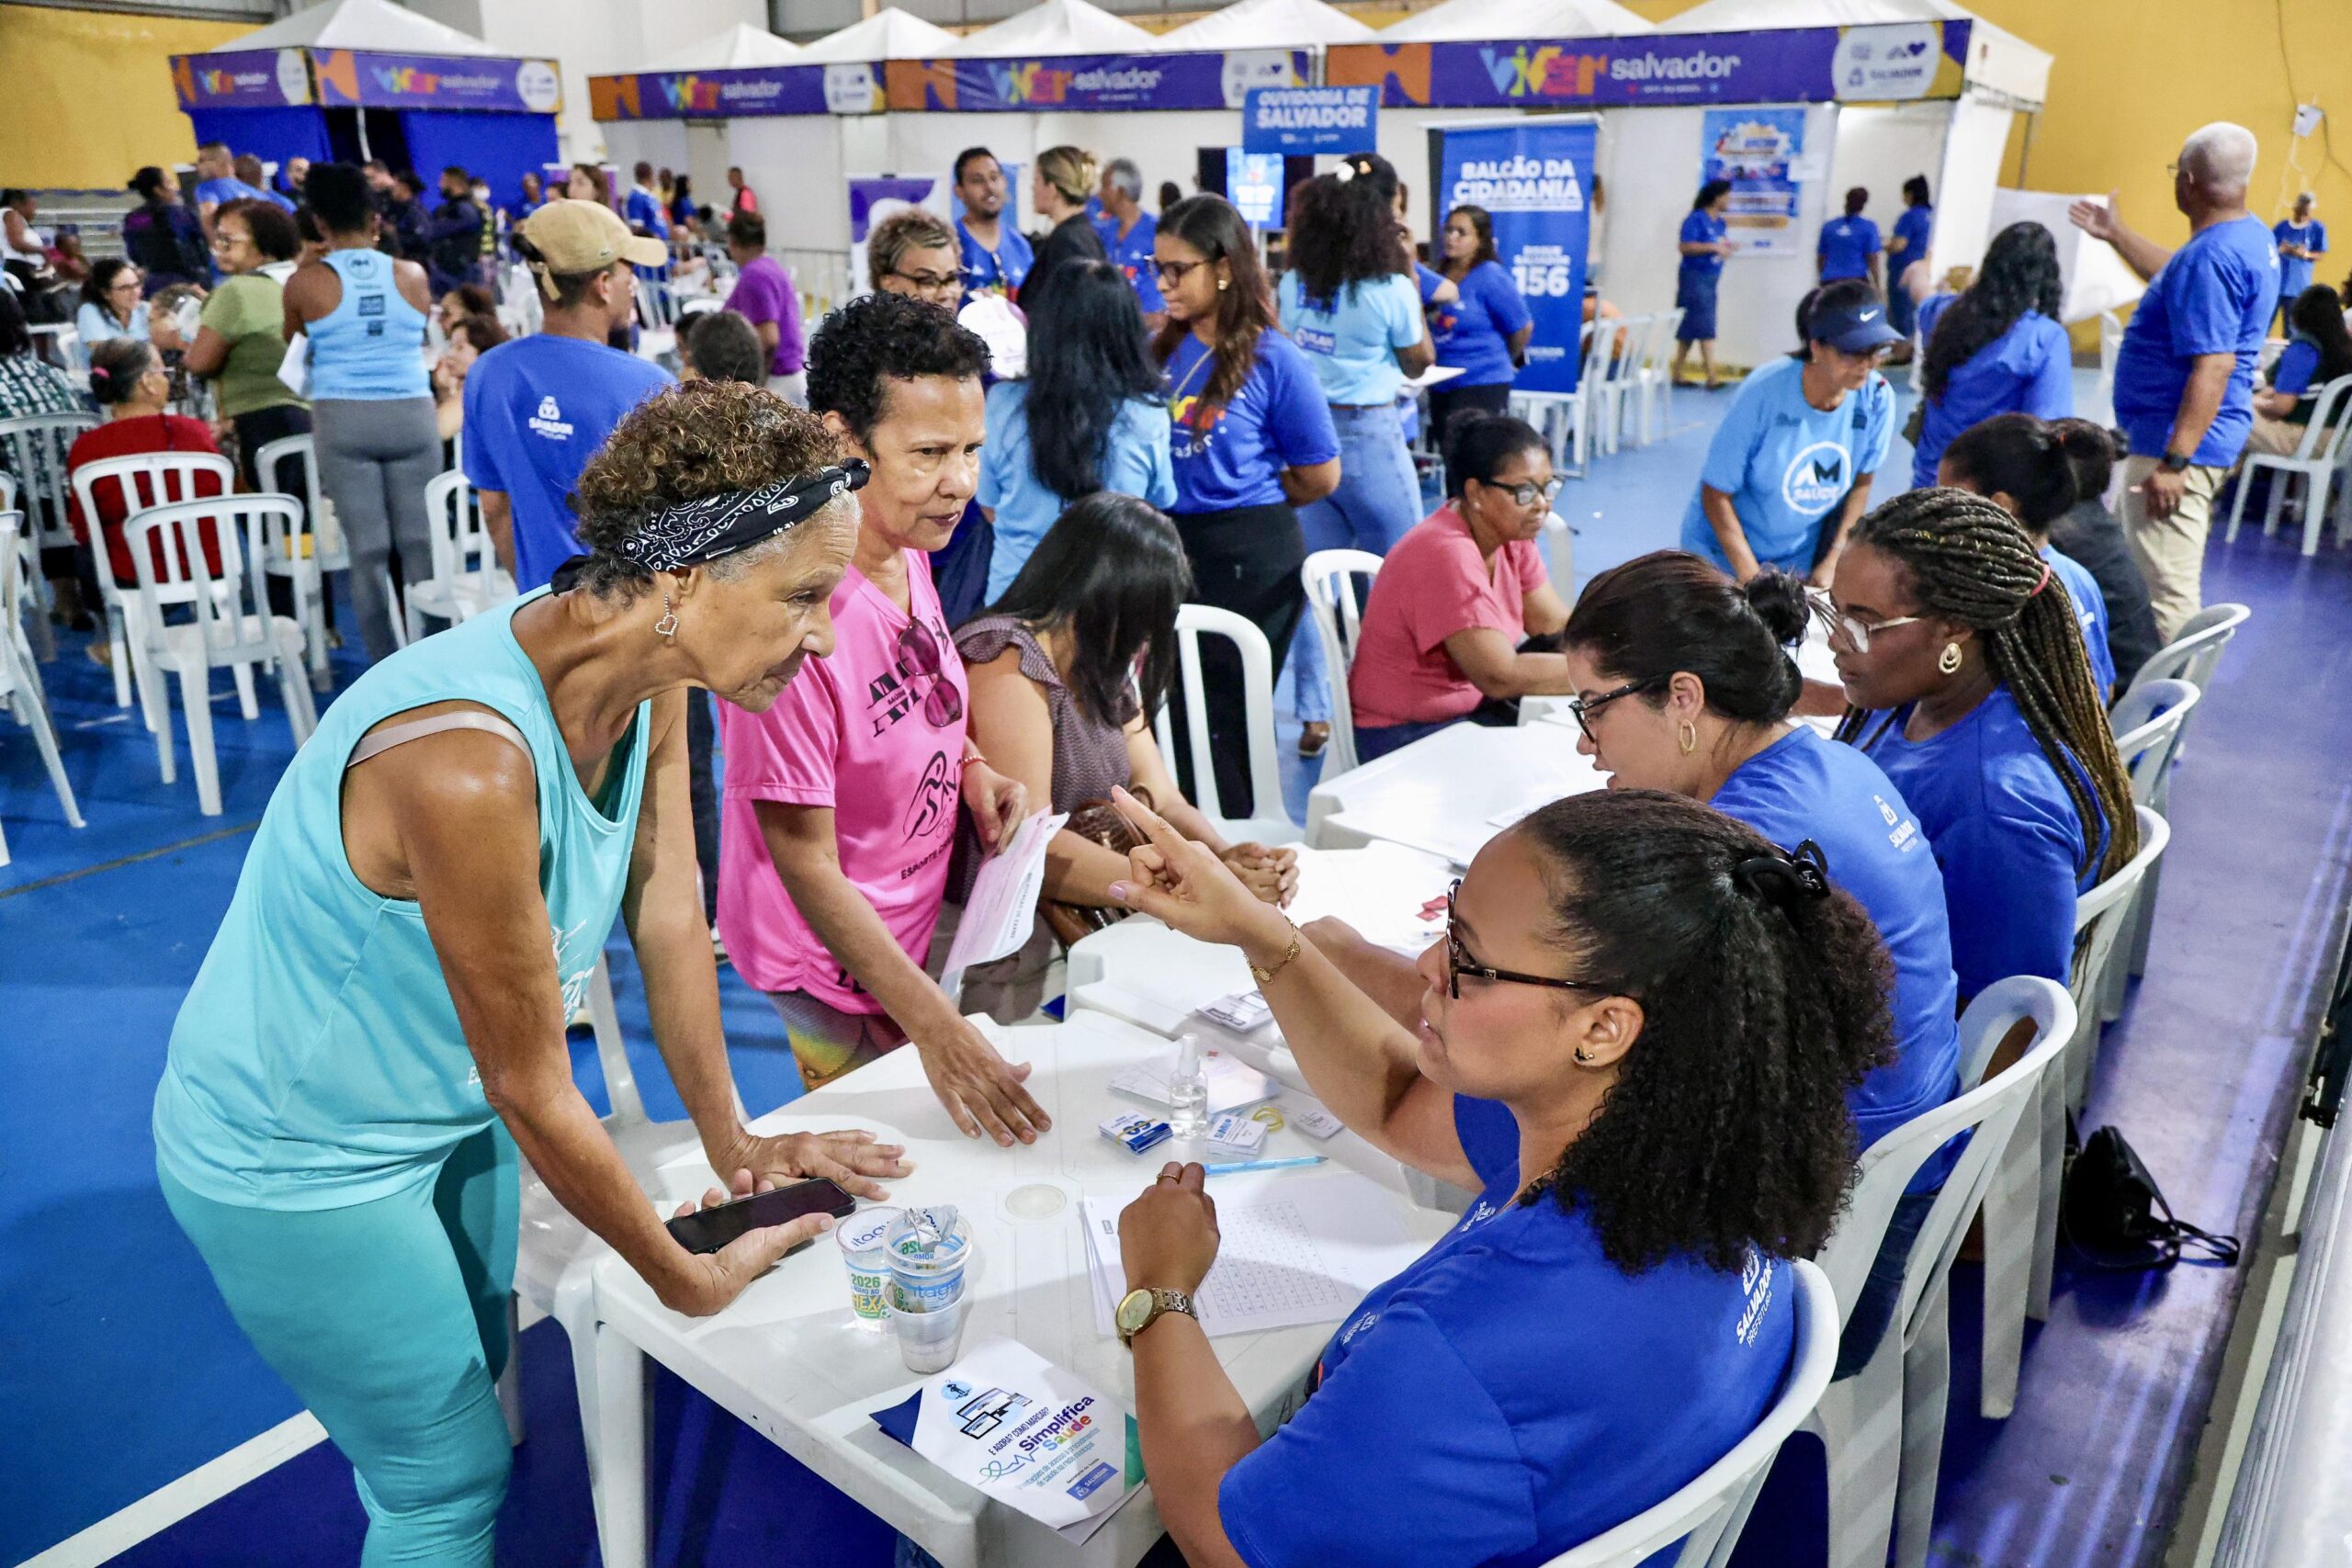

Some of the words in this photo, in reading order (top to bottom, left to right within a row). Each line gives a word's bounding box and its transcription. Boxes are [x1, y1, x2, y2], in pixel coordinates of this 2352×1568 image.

[1611, 51, 1741, 80] salvador
[1345, 88, 1371, 106] DE
[1256, 106, 1368, 129] SALVADOR
[1461, 155, 1543, 180] BALCÃO
[1544, 159, 1576, 178] DA
[1453, 179, 1584, 200] CIDADANIA
[1511, 266, 1571, 297] 156
[900, 849, 939, 880] ESPORTE
[851, 1272, 881, 1288] 2026
[992, 1434, 1013, 1452] AGORA?
[1012, 1423, 1030, 1438] COMO
[1025, 1406, 1050, 1428] MARCAR?
[1018, 1395, 1095, 1451] Simplifica
[1042, 1415, 1092, 1451] Saúde
